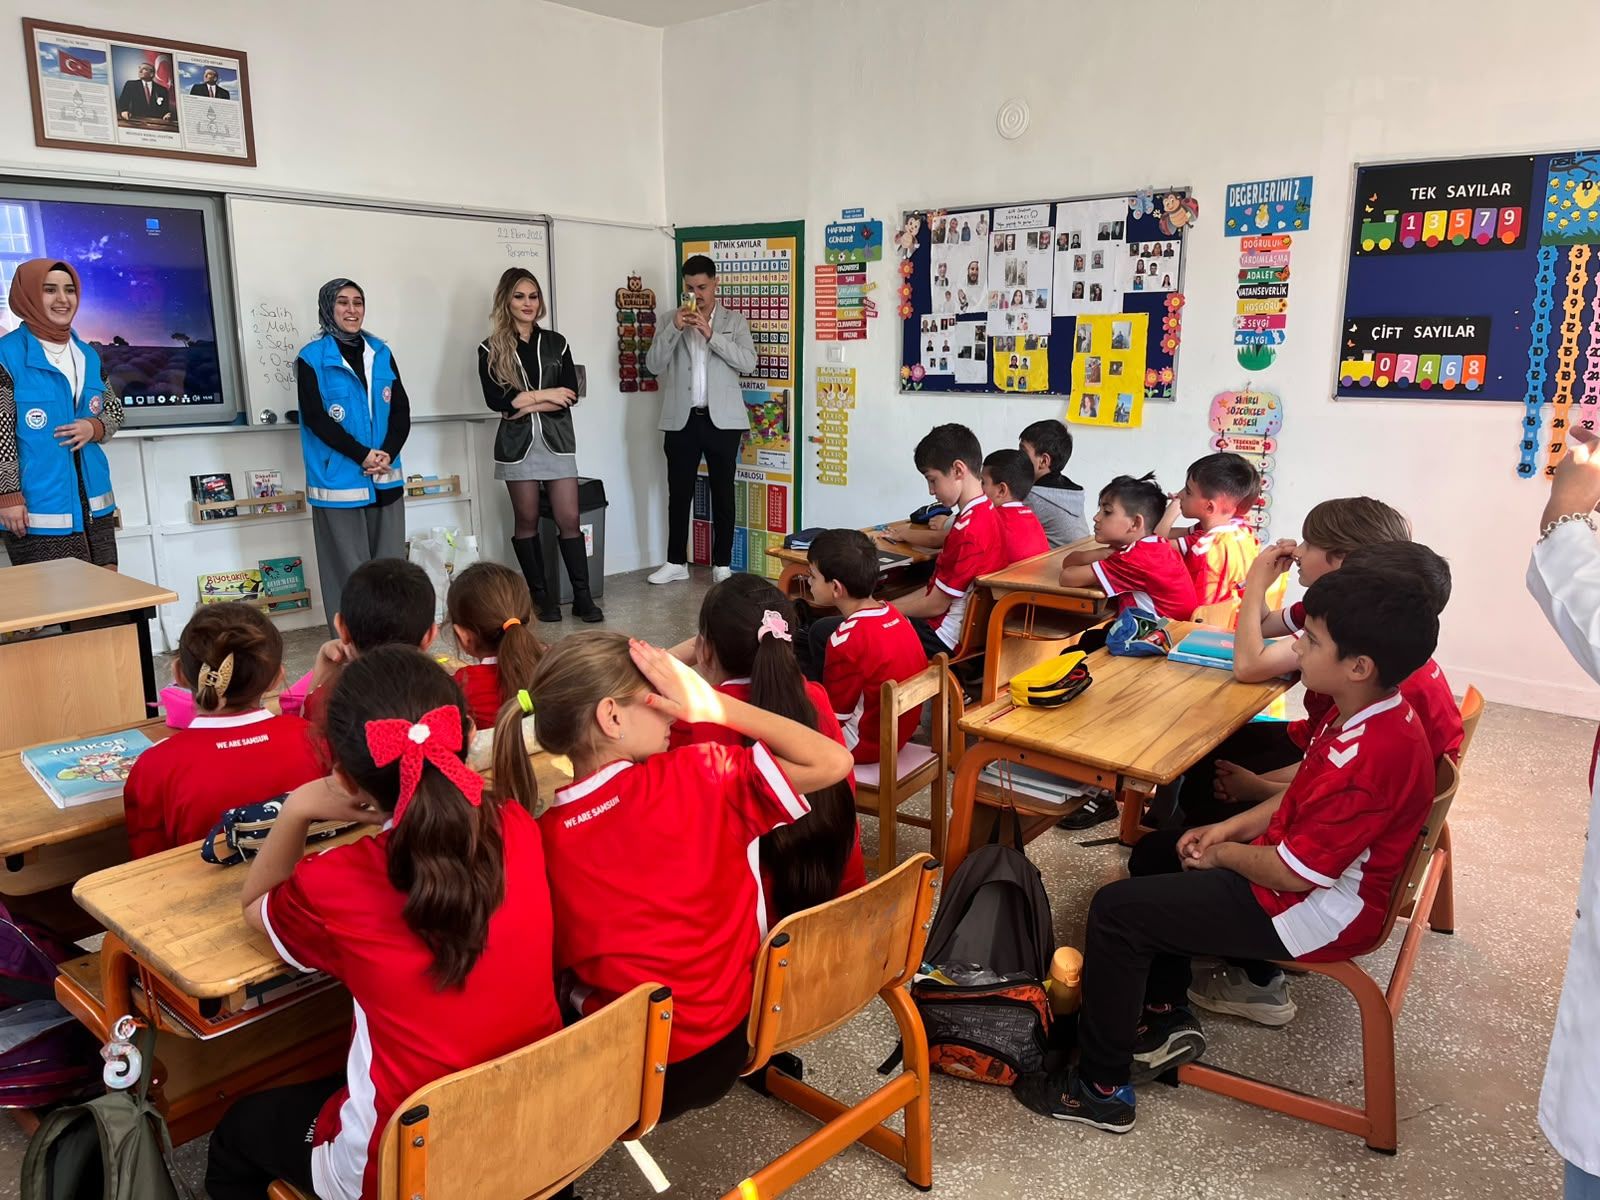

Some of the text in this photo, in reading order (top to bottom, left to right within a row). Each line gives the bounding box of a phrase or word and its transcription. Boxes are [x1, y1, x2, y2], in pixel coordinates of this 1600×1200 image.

[1582, 180, 1593, 190] 10
[1229, 179, 1300, 207] DEĞERLERİMİZ
[1410, 182, 1511, 200] TEK SAYILAR
[1406, 210, 1514, 230] 1 3 5 7 9
[714, 240, 761, 249] RİTMİK SAYILAR
[1543, 250, 1550, 260] 2
[1575, 248, 1583, 259] 3
[1247, 271, 1274, 280] ADALET
[1540, 274, 1549, 284] 4
[1572, 273, 1580, 283] 6
[1238, 284, 1286, 296] VATANSEVERLİK
[1539, 298, 1547, 308] 6
[1570, 298, 1578, 308] 9
[260, 303, 293, 320] Salih
[1248, 316, 1270, 328] SEVGİ
[253, 324, 260, 333] 2
[1371, 324, 1475, 340] ÇİFT SAYILAR
[1536, 323, 1544, 332] 8
[1566, 323, 1576, 332] 12
[266, 334, 294, 355] Sefa
[1245, 336, 1268, 344] SAYGI
[1532, 347, 1543, 356] 10
[1563, 347, 1572, 356] 15
[1380, 358, 1479, 376] 0 2 4 6 8
[1531, 370, 1540, 380] 12
[1561, 371, 1571, 381] 18
[1587, 371, 1600, 381] 24
[1529, 394, 1537, 404] 14
[1557, 394, 1567, 404] 21
[1584, 395, 1598, 405] 28
[1226, 406, 1266, 416] SÖZCÜKLER
[1233, 417, 1258, 427] KÖŞESİ
[1526, 417, 1535, 426] 16
[1553, 419, 1564, 428] 24
[1581, 420, 1594, 430] 32
[1524, 440, 1533, 450] 18
[1551, 443, 1562, 453] 27
[1518, 463, 1531, 473] 20
[737, 471, 764, 480] TABLOSU
[207, 572, 250, 584] Biyotaklit
[229, 739, 243, 748] ARE
[242, 734, 269, 746] SAMSUN
[564, 795, 620, 829] WE ARE SAMSUN
